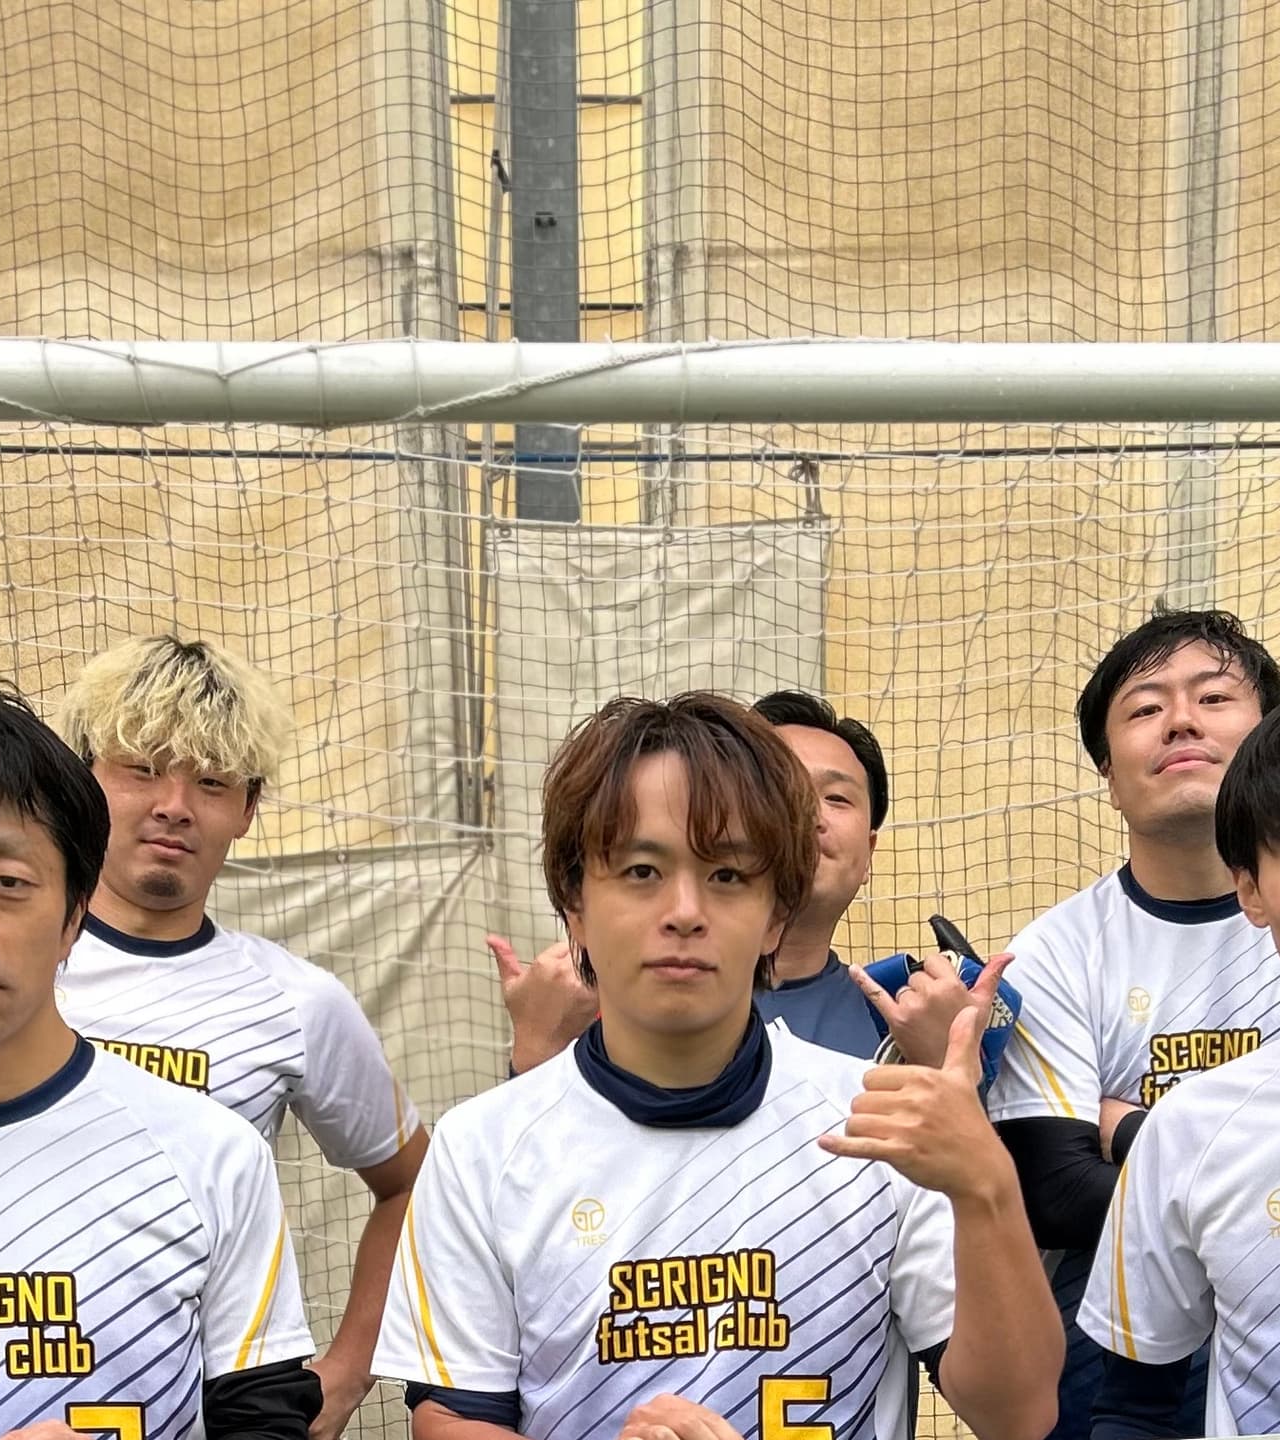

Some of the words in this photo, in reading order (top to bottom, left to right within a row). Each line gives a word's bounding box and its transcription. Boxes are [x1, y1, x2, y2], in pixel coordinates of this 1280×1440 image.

[610, 1249, 775, 1311] SCRIGNO
[5, 1325, 95, 1378] club
[596, 1307, 710, 1364] futsal
[714, 1301, 790, 1352] club
